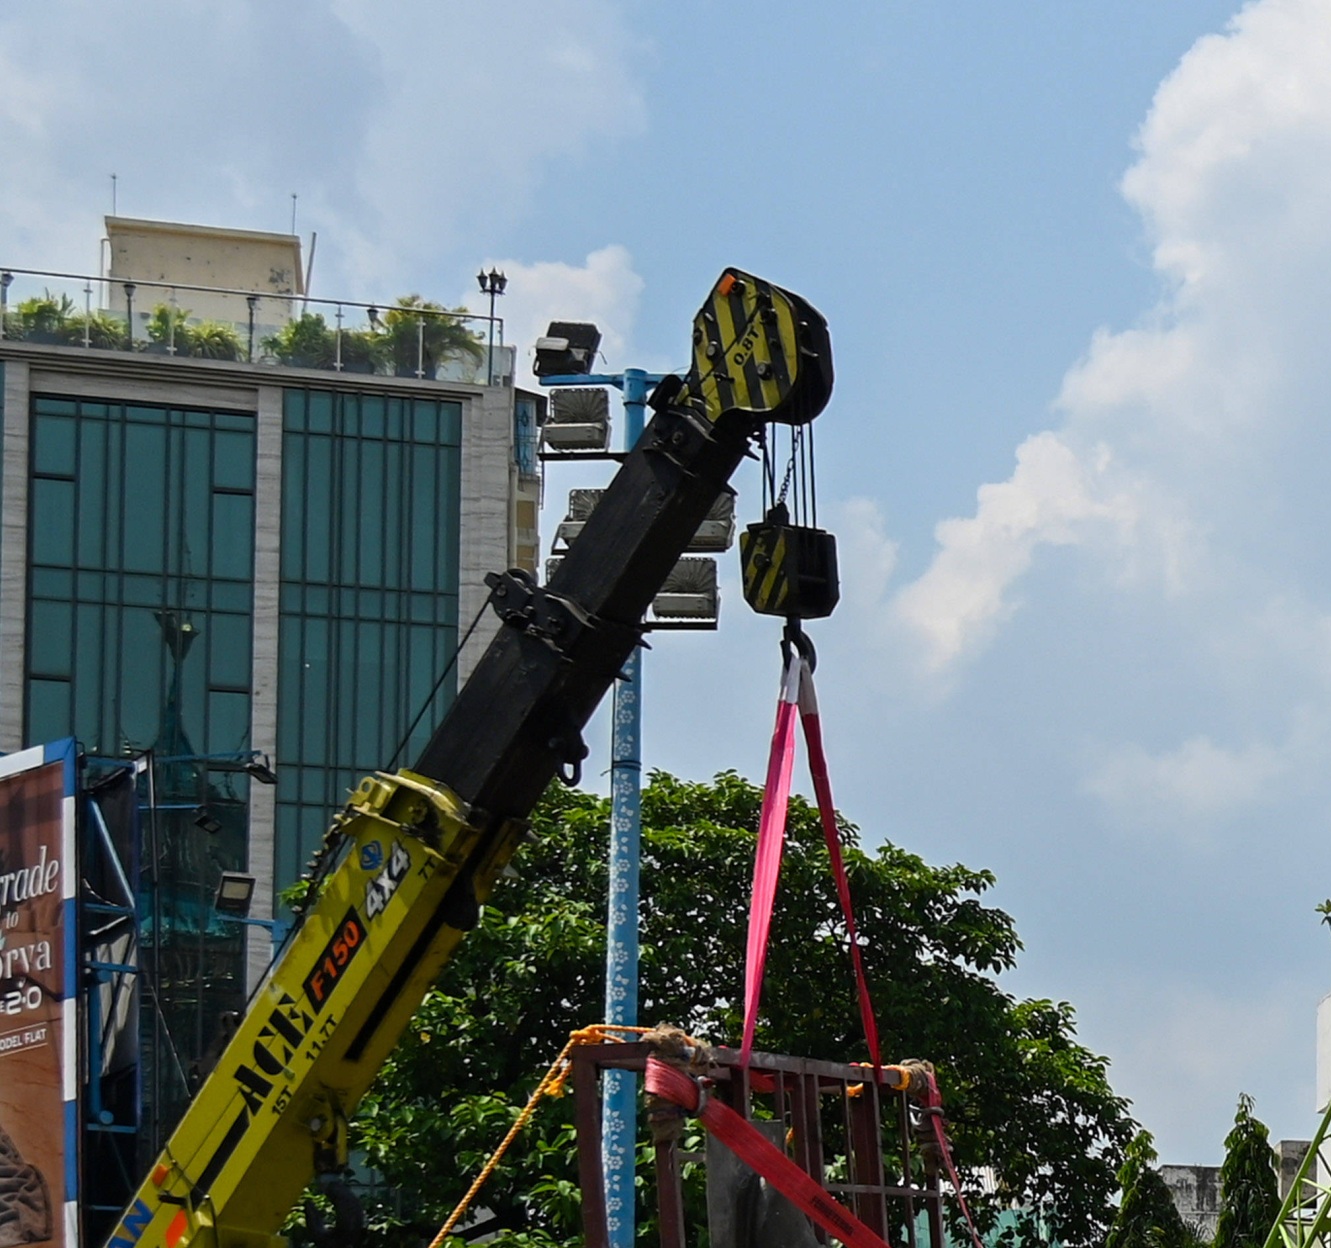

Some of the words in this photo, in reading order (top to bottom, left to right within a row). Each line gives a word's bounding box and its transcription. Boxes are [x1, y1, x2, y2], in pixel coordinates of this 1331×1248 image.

[0, 845, 59, 906] rade
[310, 920, 361, 1001] F150
[25, 1028, 47, 1044] FLAT
[233, 993, 315, 1117] ACE
[271, 1085, 295, 1116] 15T
